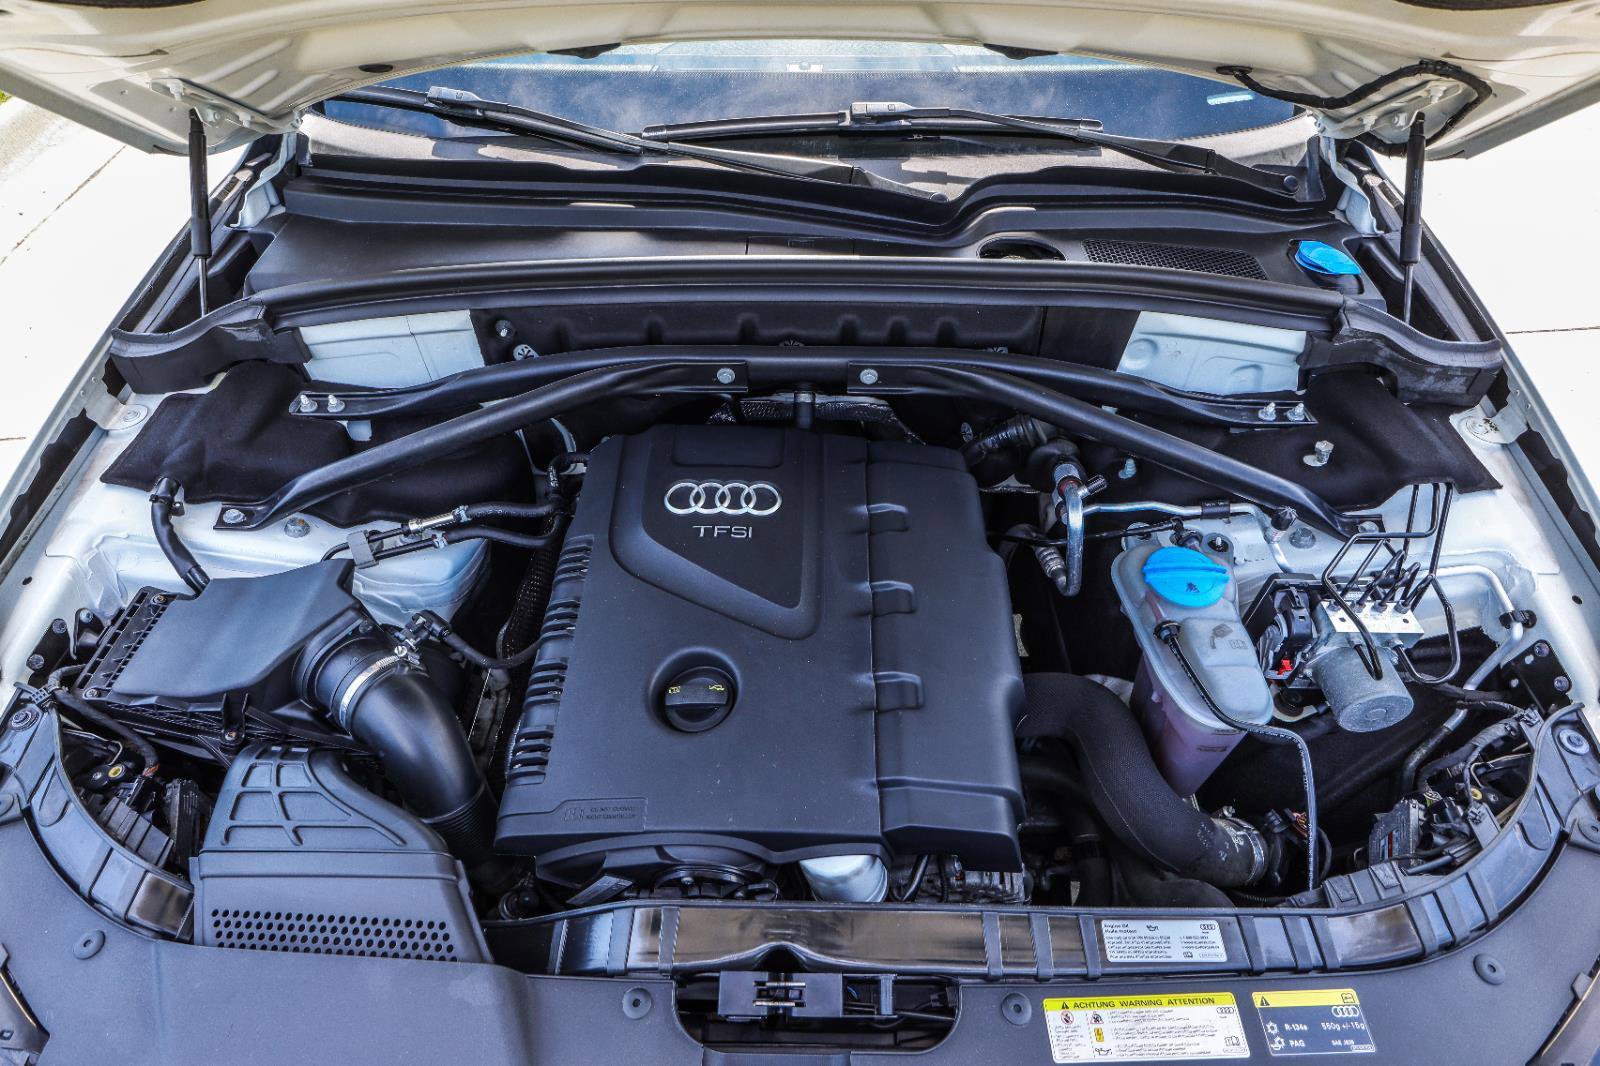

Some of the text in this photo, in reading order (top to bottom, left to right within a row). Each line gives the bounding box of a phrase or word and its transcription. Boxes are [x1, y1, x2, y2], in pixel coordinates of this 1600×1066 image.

[692, 525, 753, 539] TFSI
[1073, 997, 1215, 1009] ACHTUNG WARNING ATTENTION
[1289, 1039, 1306, 1047] PAG
